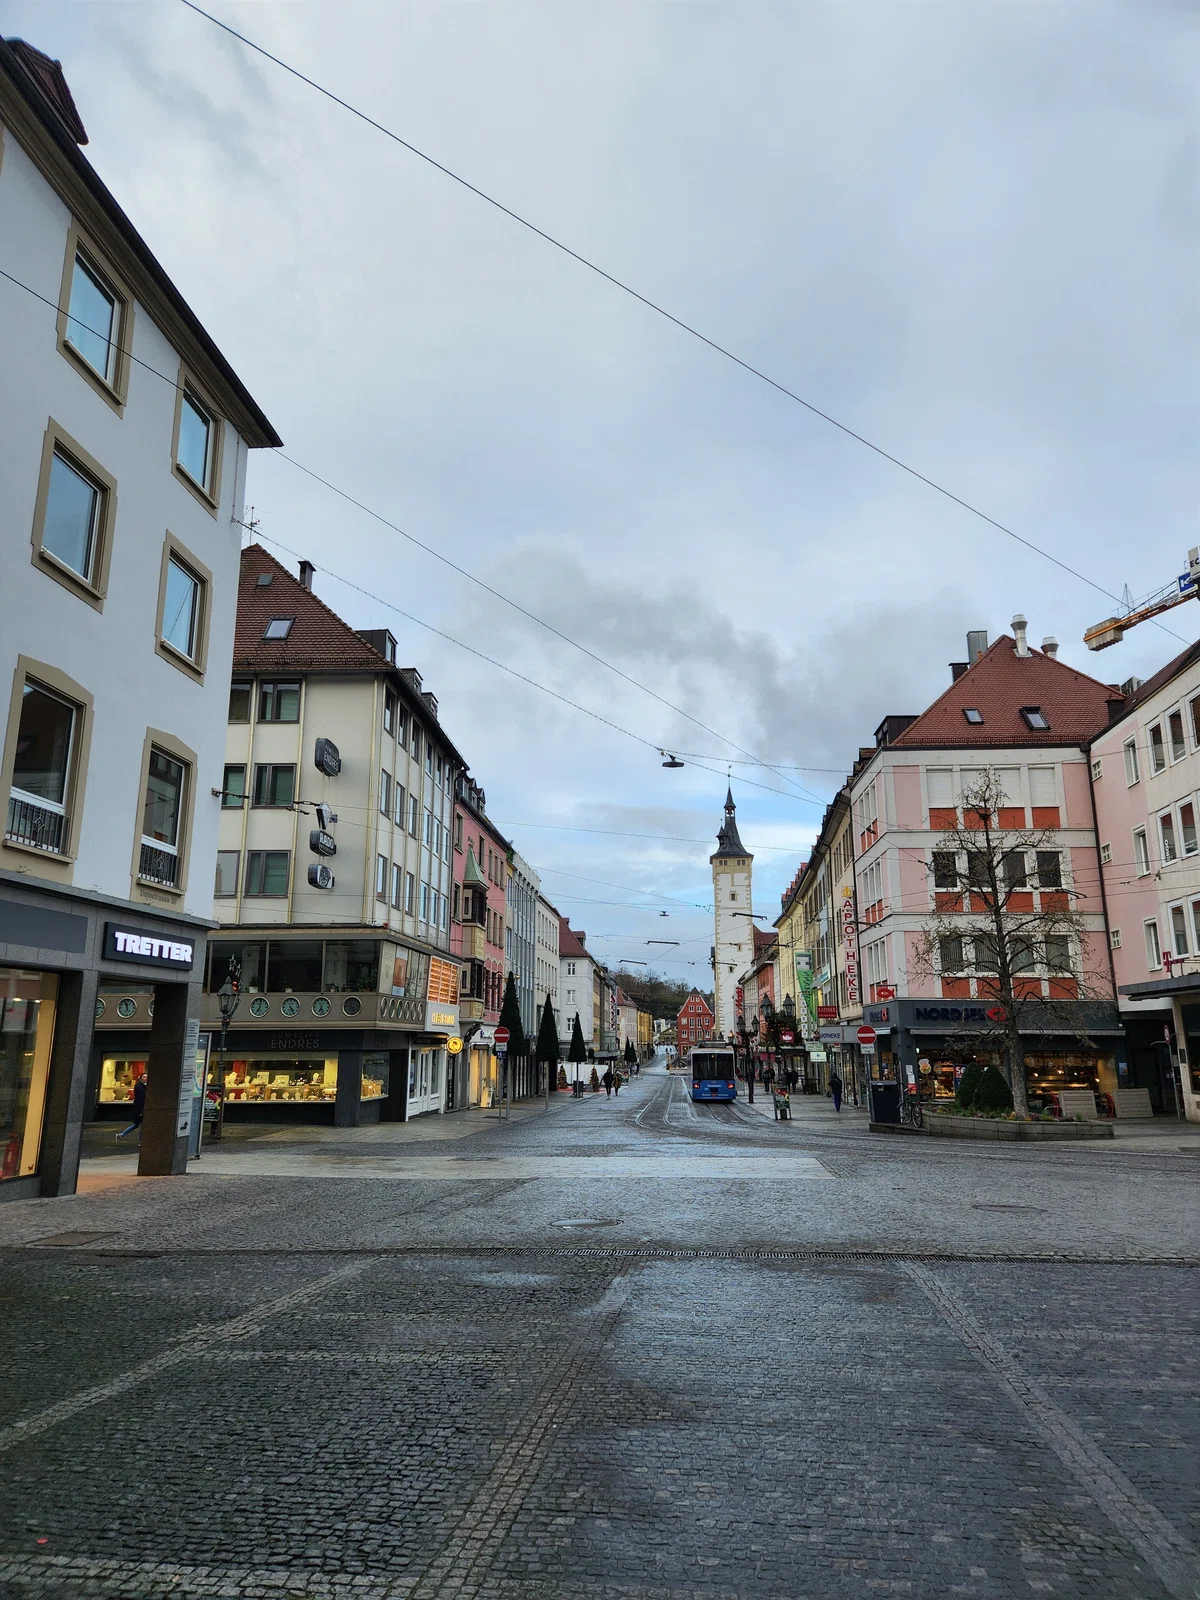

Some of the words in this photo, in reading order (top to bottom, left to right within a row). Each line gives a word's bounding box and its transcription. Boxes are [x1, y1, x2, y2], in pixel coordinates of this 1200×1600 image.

[324, 751, 339, 771] ENDRES
[319, 833, 334, 849] RADO
[114, 931, 192, 962] TRETTER
[843, 900, 857, 1000] APOTHEKE
[915, 1007, 986, 1021] NORDSEE
[271, 1039, 320, 1049] ENDRES
